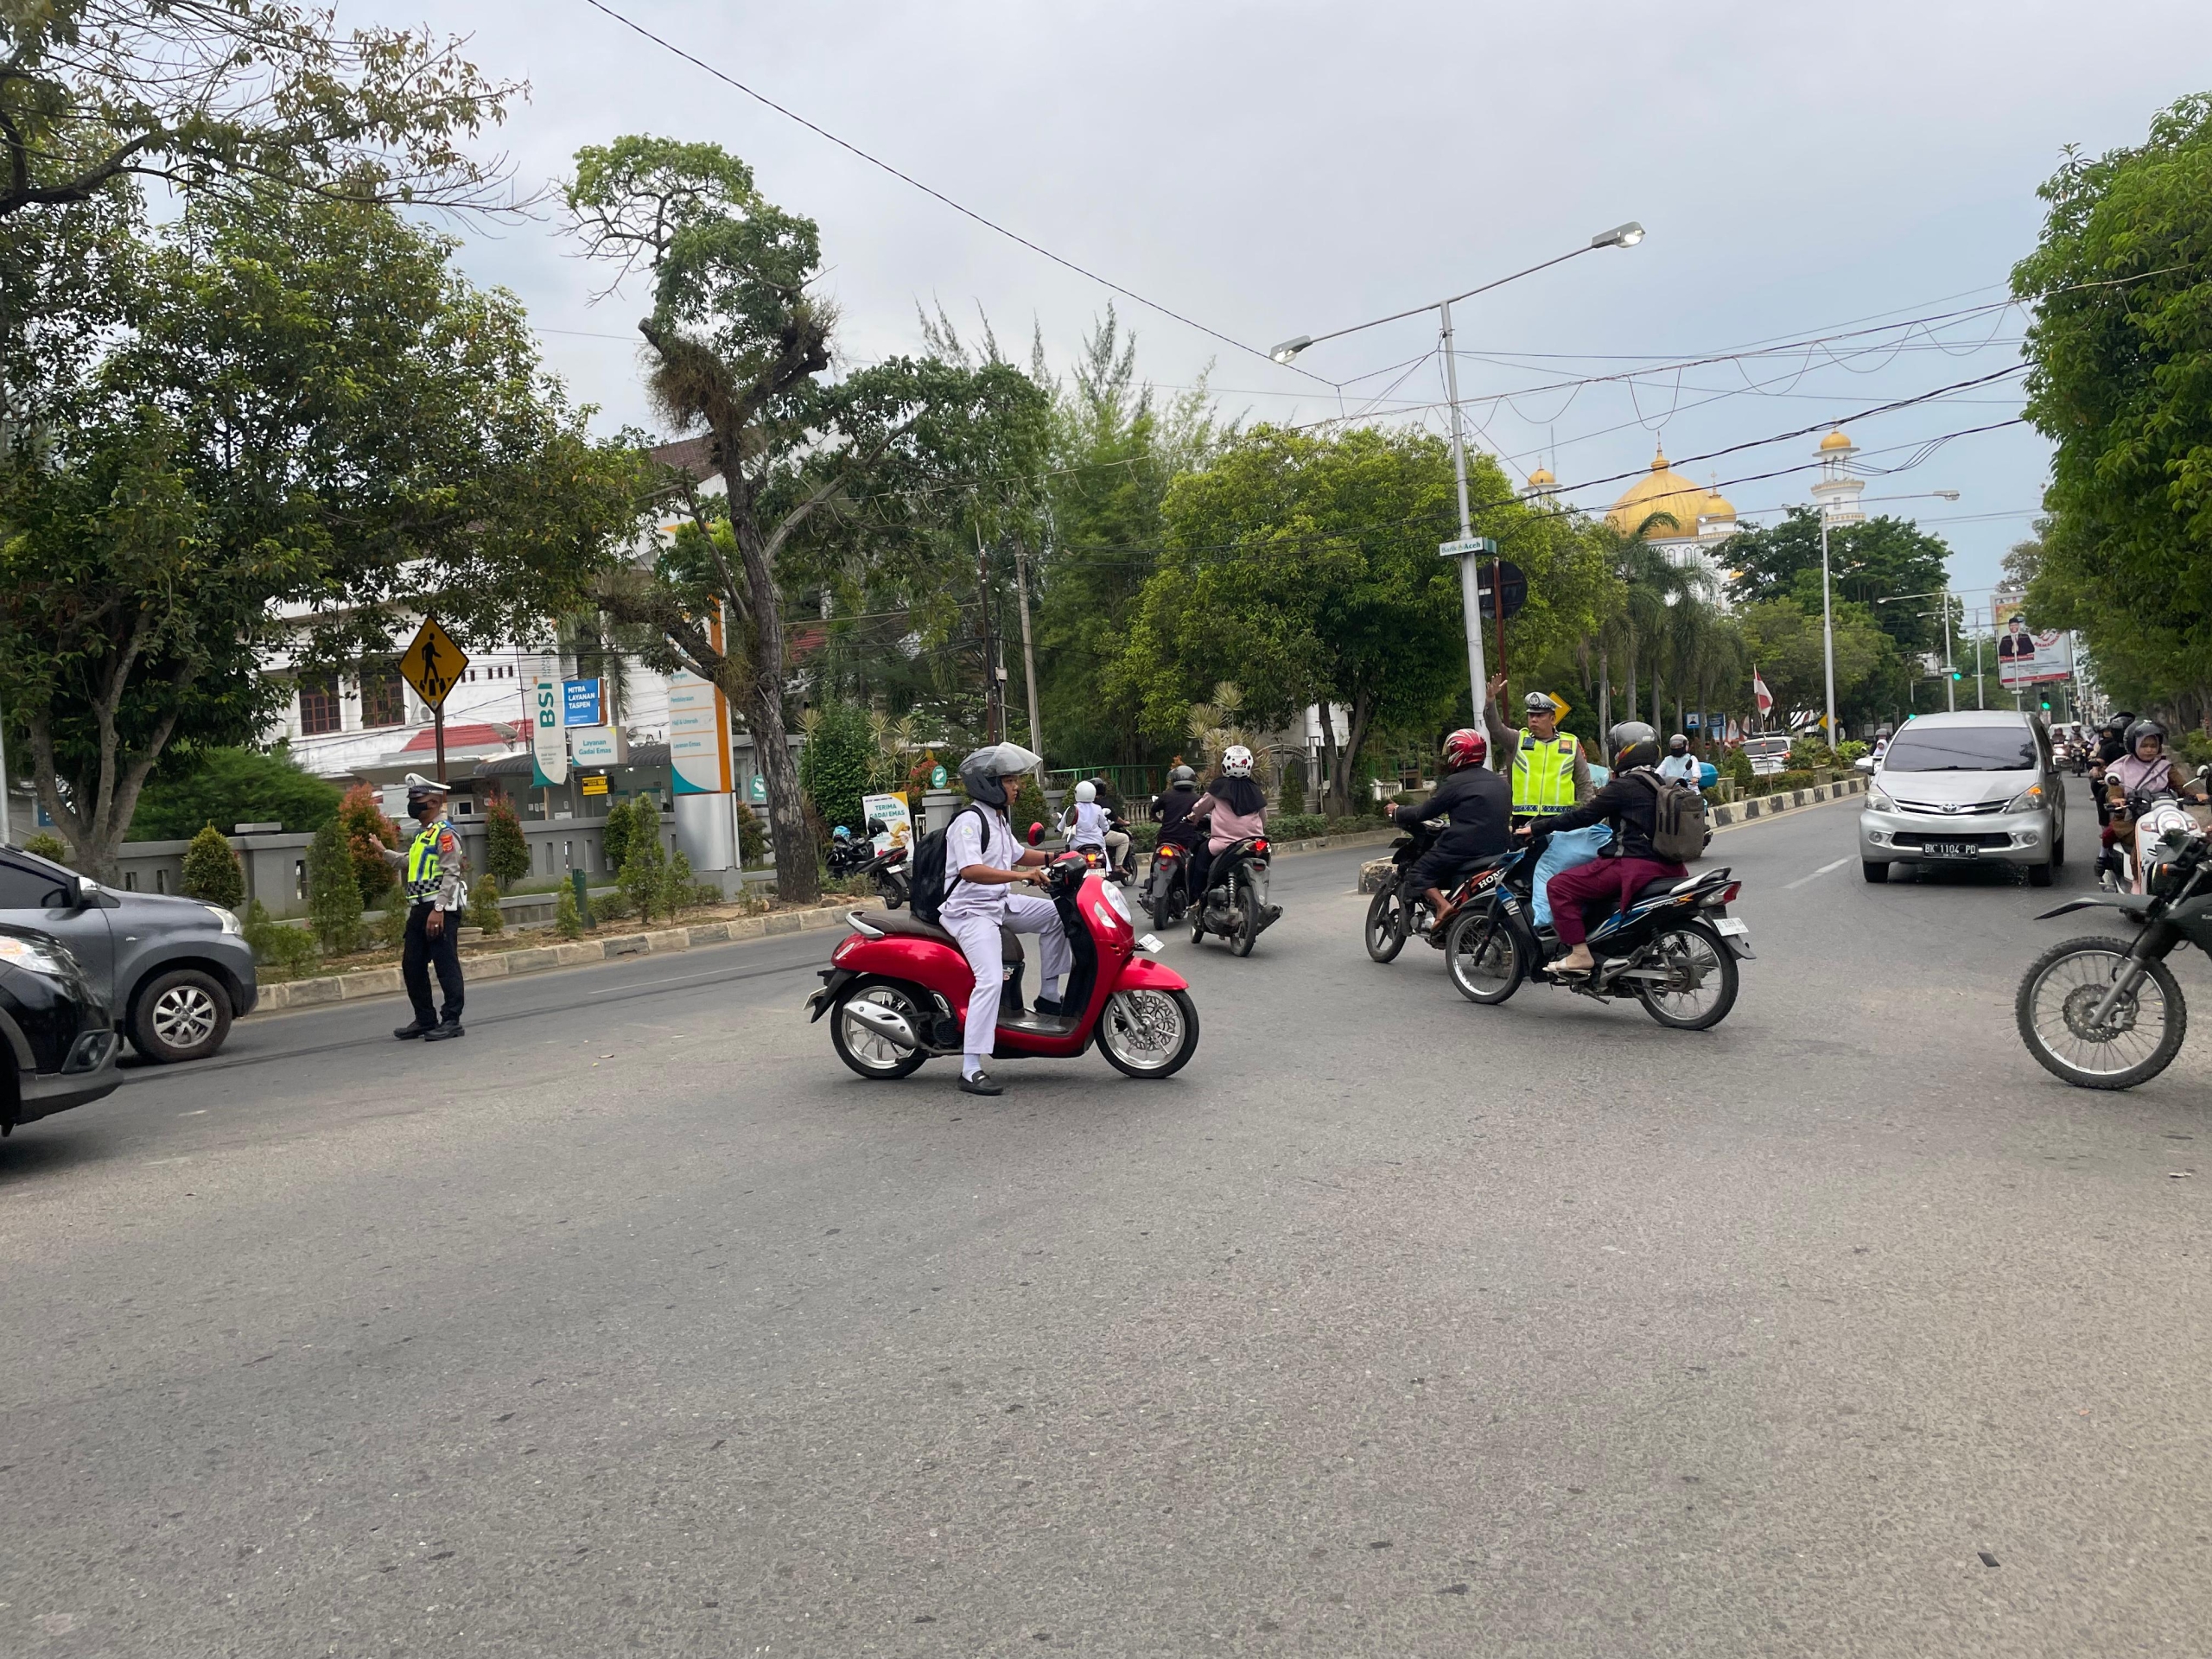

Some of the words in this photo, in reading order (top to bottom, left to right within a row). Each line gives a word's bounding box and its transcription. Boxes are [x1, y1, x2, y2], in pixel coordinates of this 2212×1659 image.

[1464, 541, 1481, 550] Aceh
[568, 685, 586, 694] MITRA
[568, 692, 595, 702] LAYANAN
[537, 683, 556, 728] BSI
[569, 701, 591, 709] TASPEN
[1924, 843, 1936, 853] BK
[1940, 844, 1960, 854] 1104
[1965, 844, 1976, 854] PD
